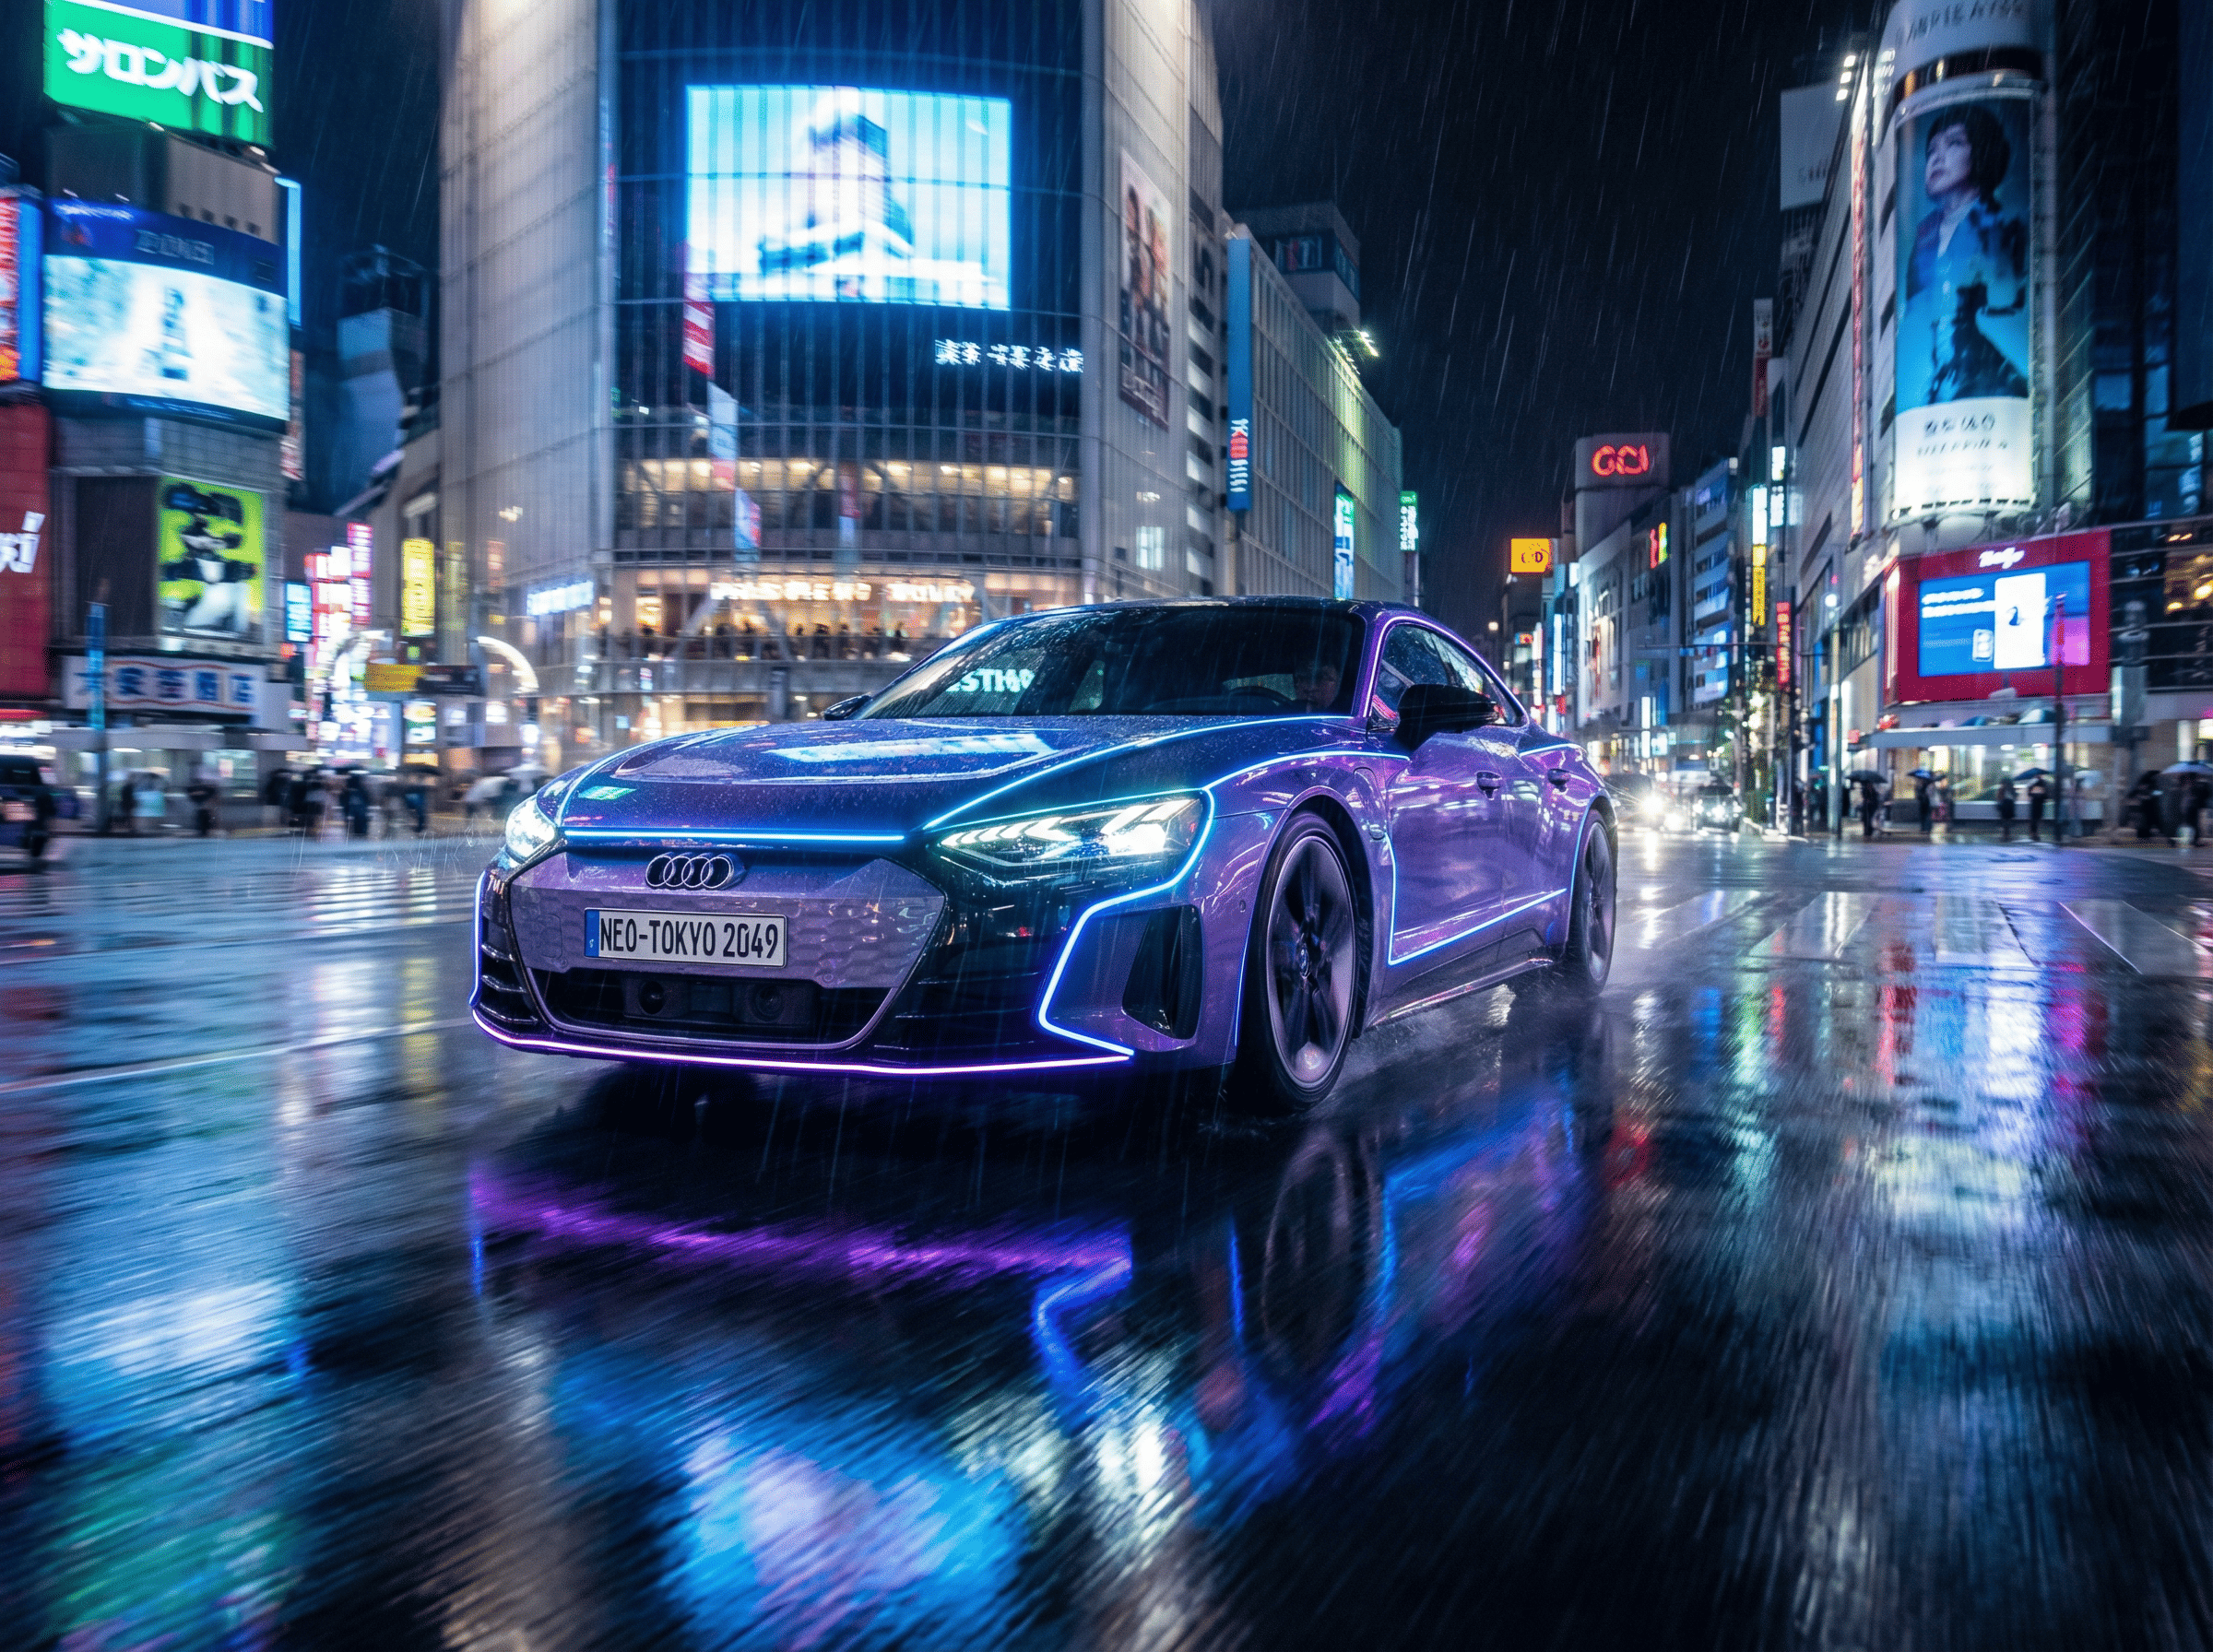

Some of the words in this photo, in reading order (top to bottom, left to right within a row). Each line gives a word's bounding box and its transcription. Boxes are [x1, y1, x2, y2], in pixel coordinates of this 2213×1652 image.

[56, 28, 265, 113] サロンパス
[599, 917, 716, 956] NEO-TOKYO
[722, 923, 779, 959] 2049
